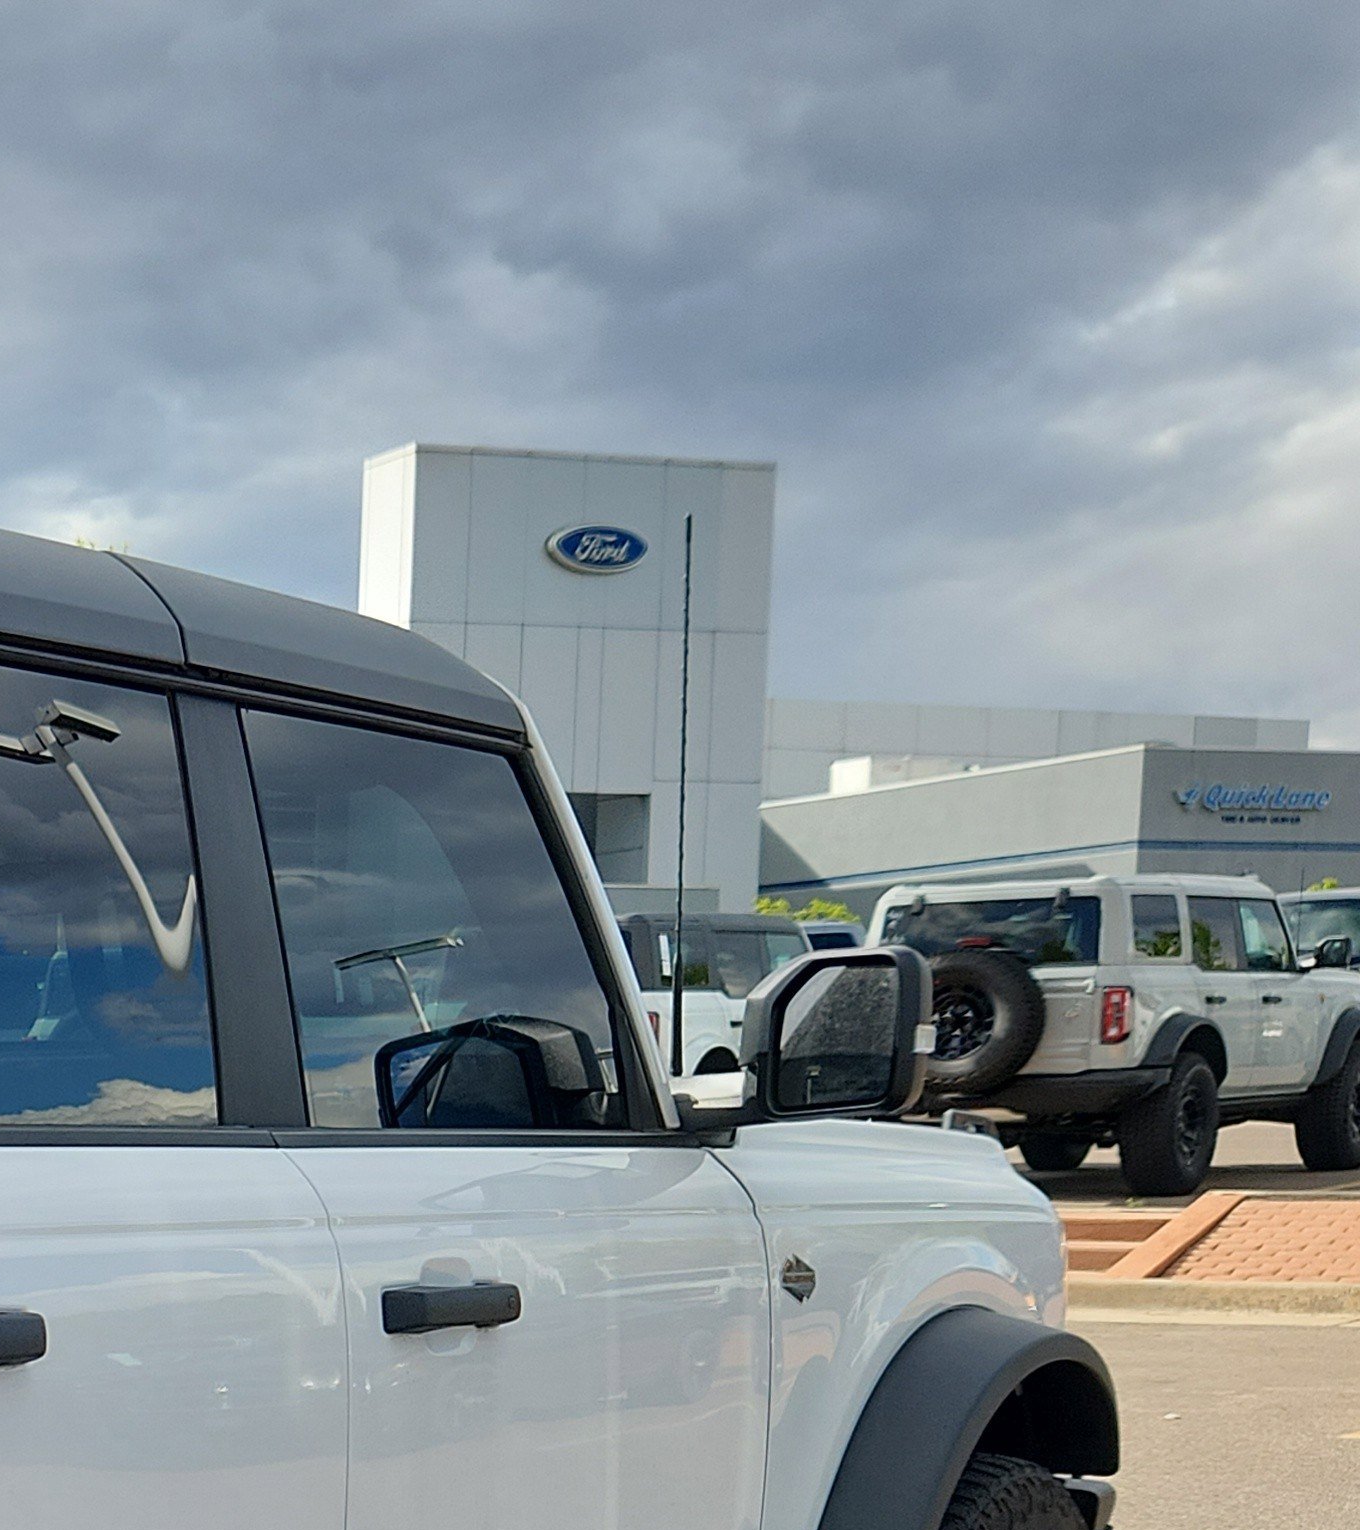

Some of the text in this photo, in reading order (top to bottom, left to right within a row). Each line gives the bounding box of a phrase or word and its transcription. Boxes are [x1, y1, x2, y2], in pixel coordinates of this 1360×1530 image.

[573, 532, 631, 563] Ford
[1204, 783, 1332, 811] Quick Lane
